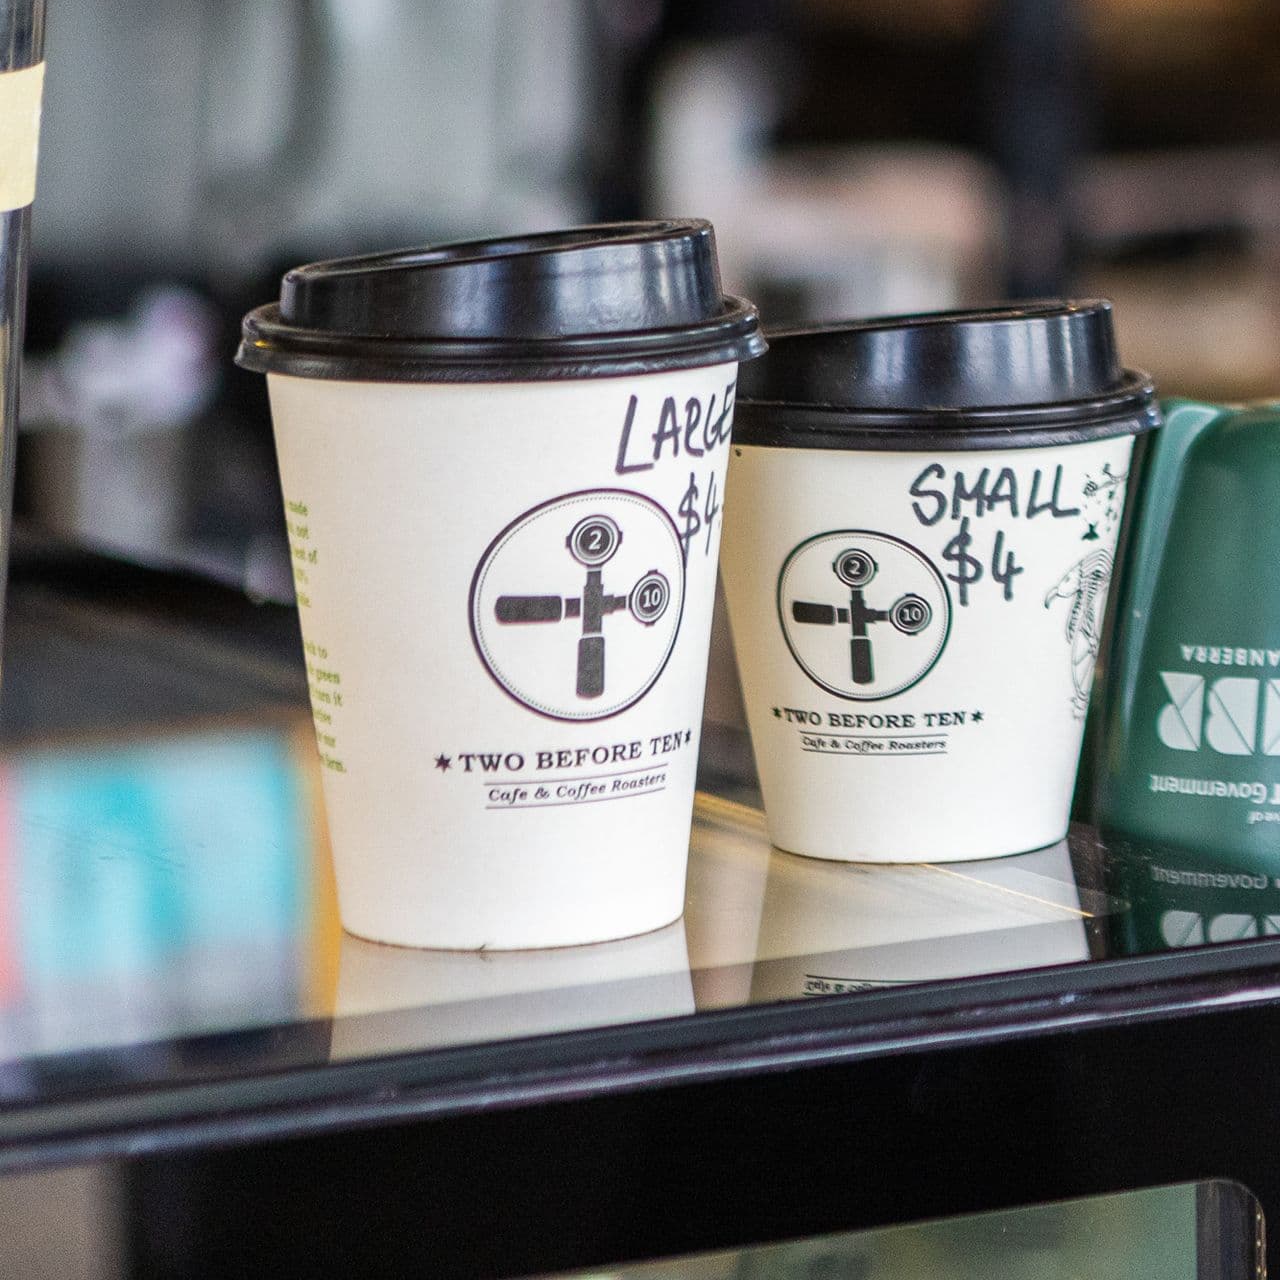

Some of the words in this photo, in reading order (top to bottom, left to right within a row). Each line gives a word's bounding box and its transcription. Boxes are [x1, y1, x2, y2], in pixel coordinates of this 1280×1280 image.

[910, 463, 1081, 527] SMALL
[588, 530, 602, 550] 2
[848, 559, 861, 575] 2
[942, 516, 1024, 607] $4
[642, 588, 661, 609] 10
[903, 607, 921, 622] 10
[784, 707, 822, 726] TWO
[828, 713, 916, 729] BEFORE
[924, 712, 966, 727] TEN
[459, 753, 525, 772] TWO
[535, 741, 643, 771] BEFORE
[650, 731, 683, 756] TEN
[803, 736, 827, 749] Cafe
[830, 739, 840, 749] &
[845, 739, 884, 753] Coffee
[889, 740, 947, 750] Roasters
[488, 788, 528, 804] Cafe
[534, 787, 550, 799] &
[556, 781, 606, 800] Coffee
[611, 771, 667, 793] Roasters
[1149, 774, 1267, 805] Government
